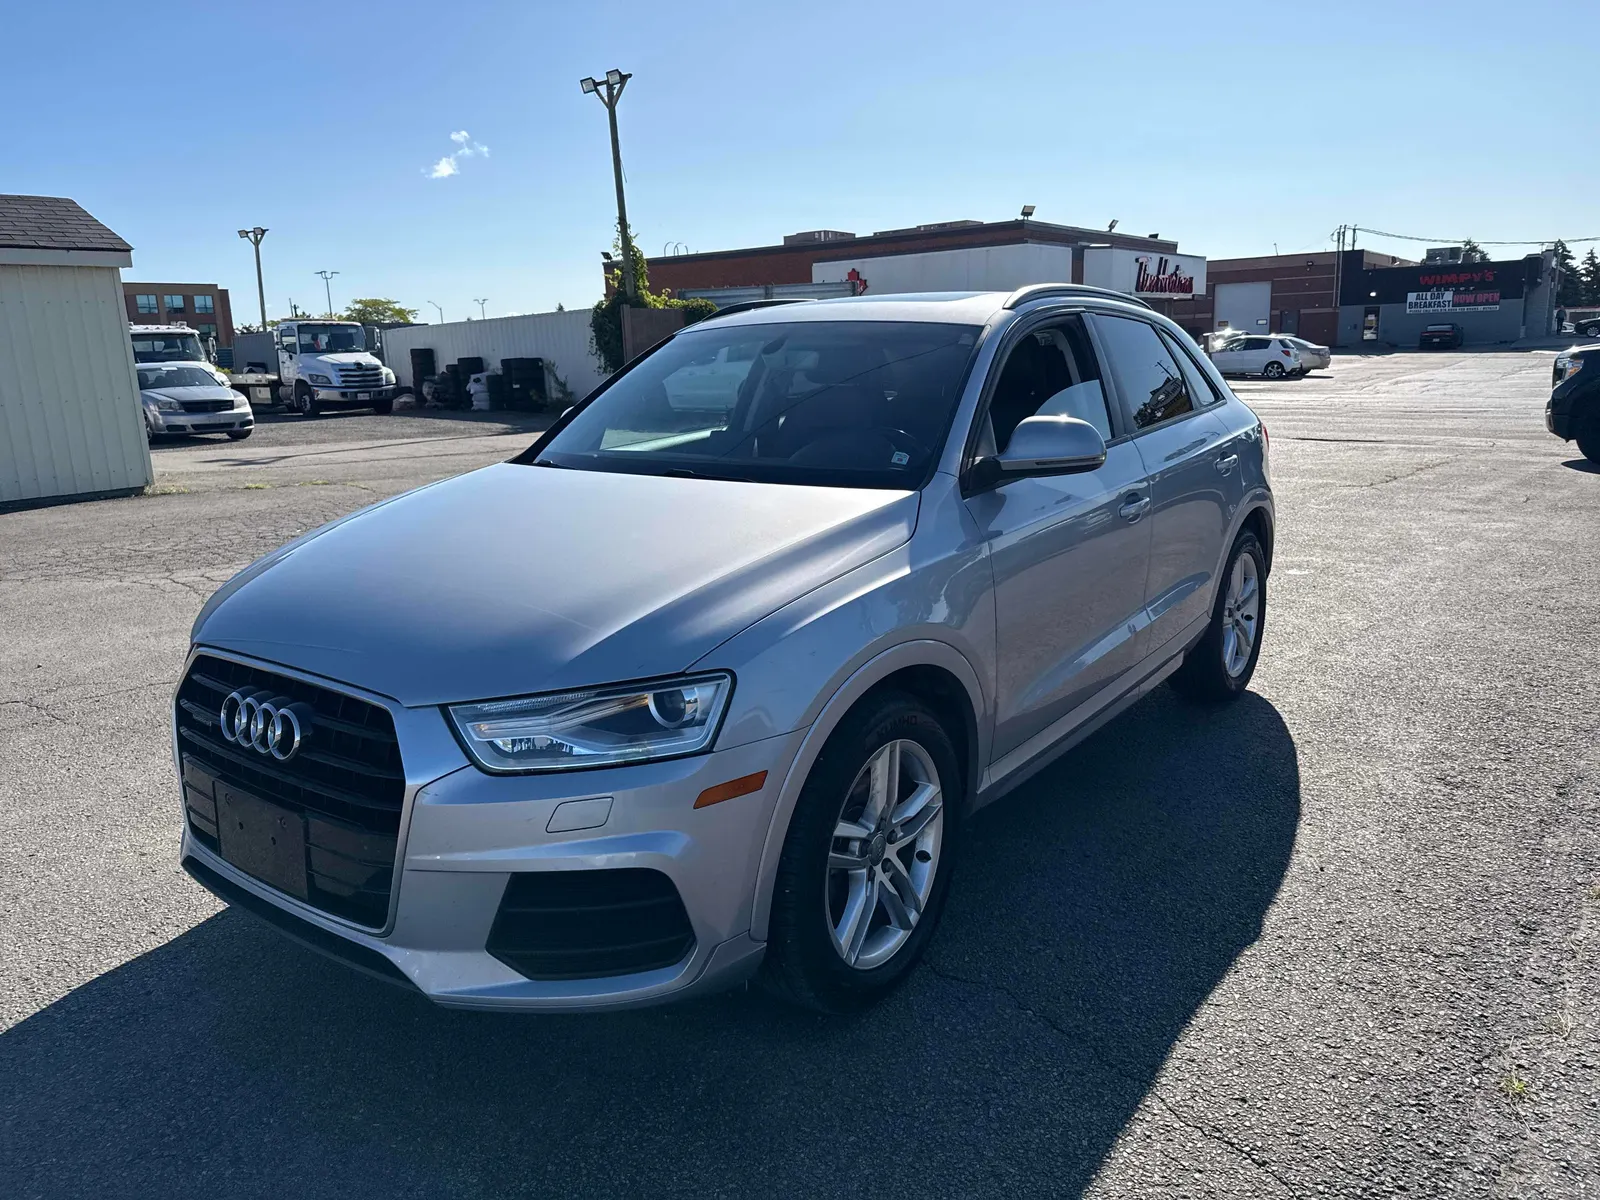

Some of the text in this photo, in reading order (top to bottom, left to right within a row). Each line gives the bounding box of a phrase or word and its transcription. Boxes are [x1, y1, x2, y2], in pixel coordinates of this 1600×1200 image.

[1420, 270, 1494, 285] WIMPY'S
[1416, 292, 1446, 301] ALL DAY
[1453, 293, 1500, 304] NOW OPEN
[1408, 300, 1452, 309] BREAKFAST
